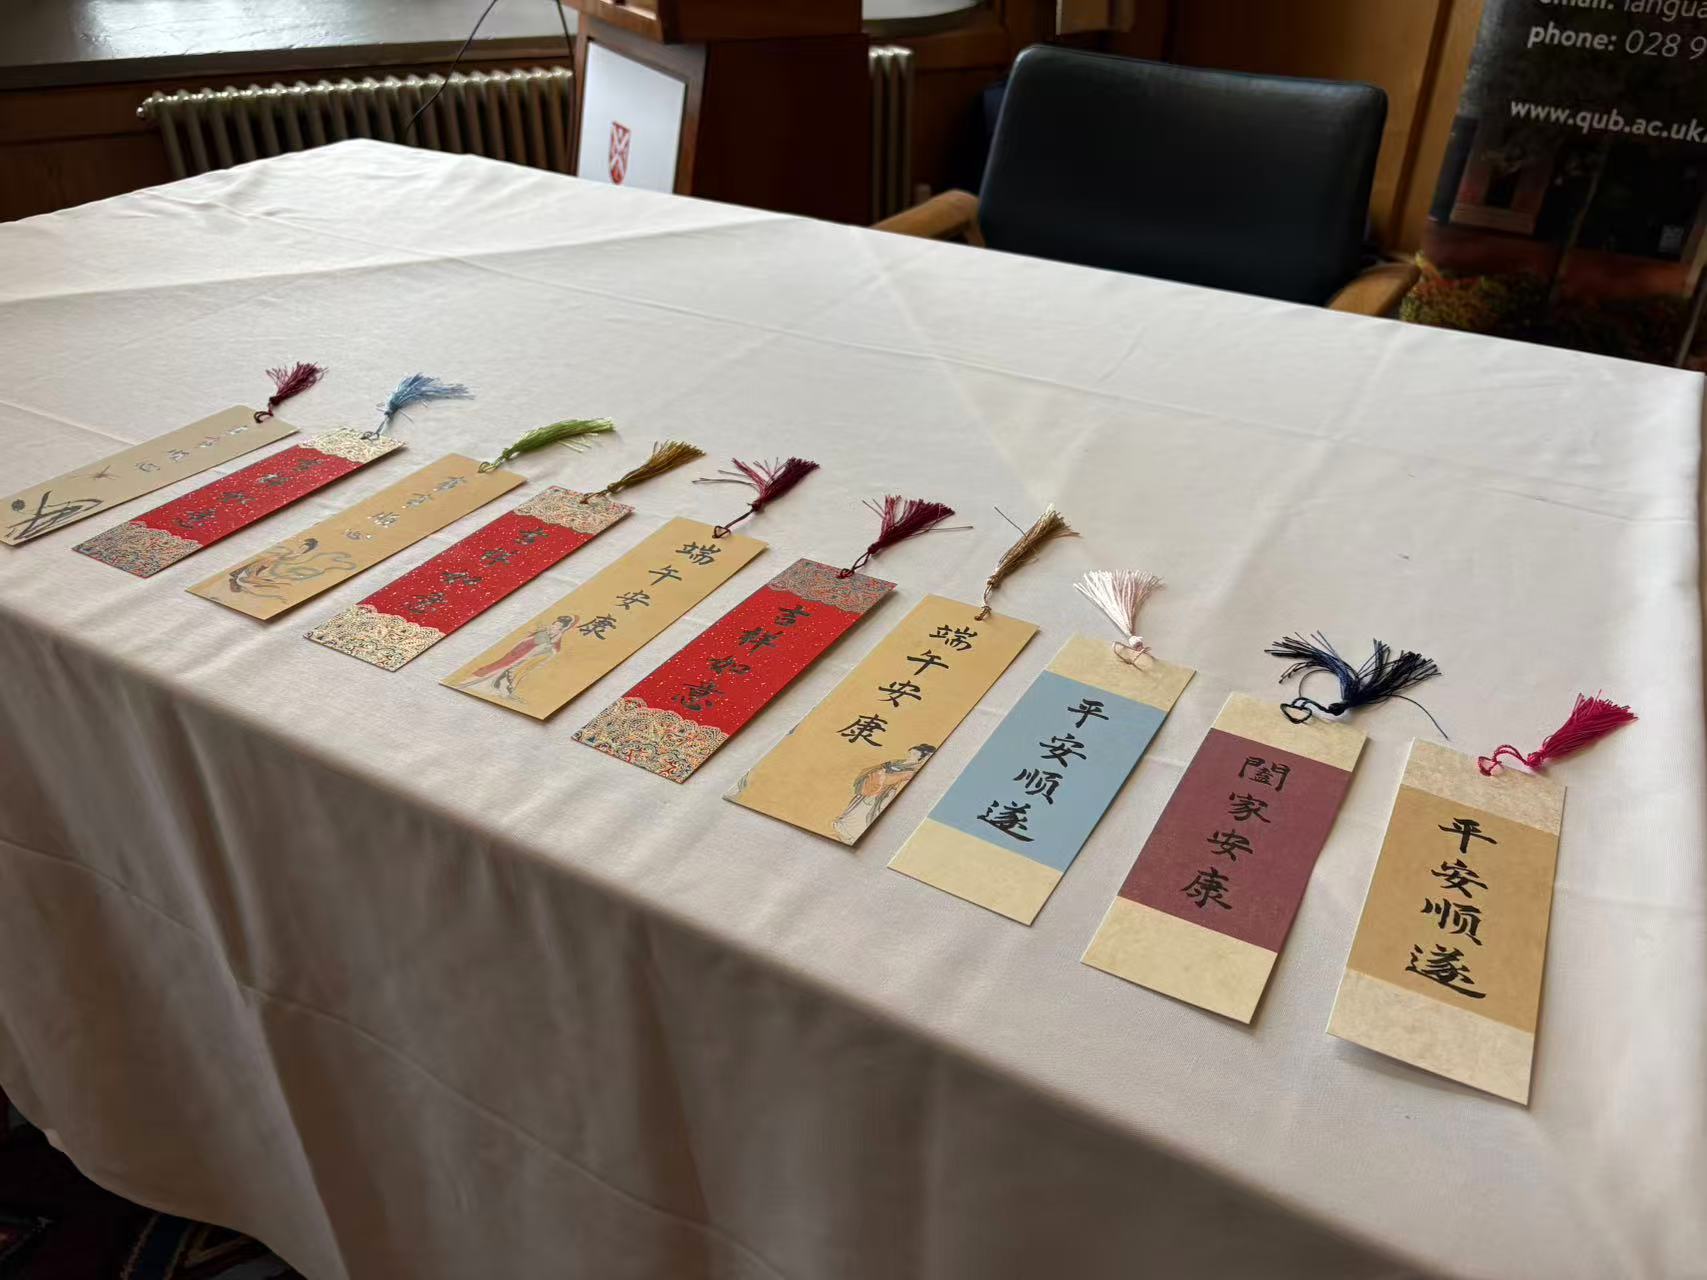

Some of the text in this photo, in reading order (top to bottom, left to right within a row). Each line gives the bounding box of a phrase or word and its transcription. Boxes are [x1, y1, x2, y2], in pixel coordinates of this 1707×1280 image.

[1527, 21, 1617, 51] phone:
[1625, 29, 1681, 58] 028
[576, 541, 721, 641] 端午安康
[671, 604, 812, 713] 吉祥如意
[836, 624, 978, 747] 端午安康
[976, 698, 1110, 843] 平安顺遂
[1405, 817, 1498, 999] 平安顺遂
